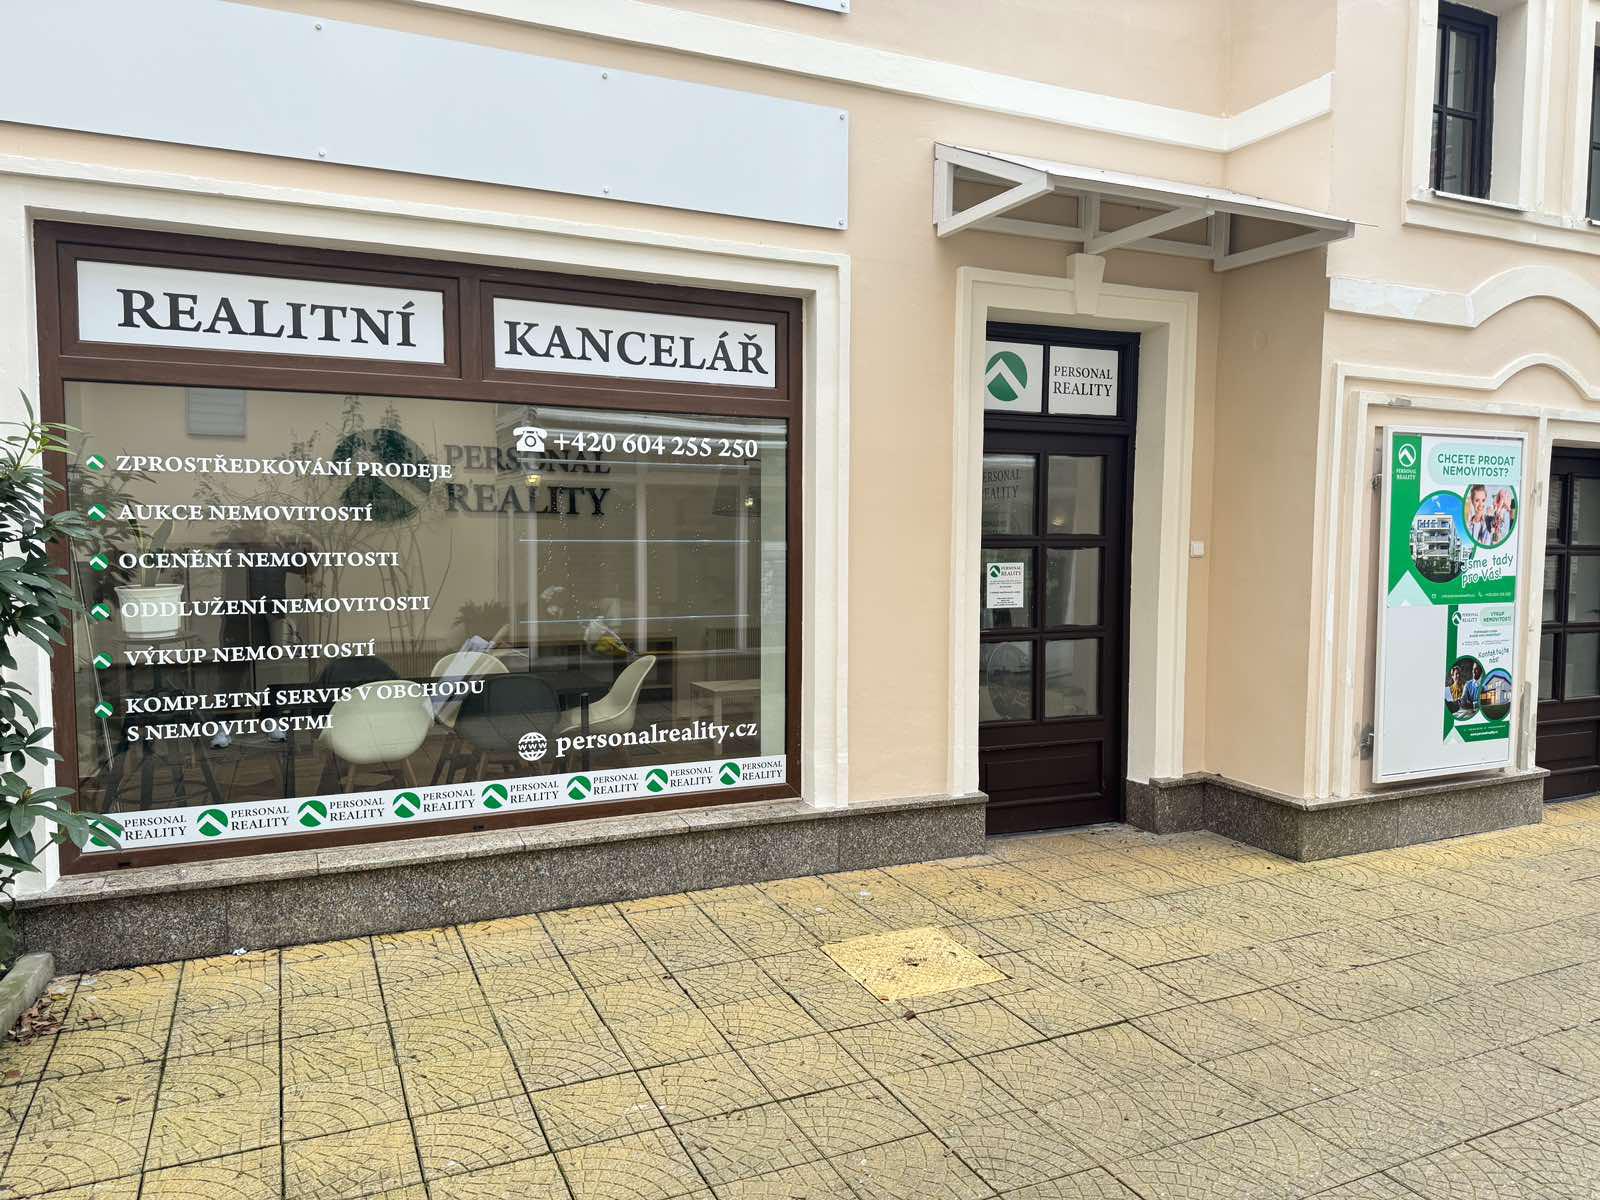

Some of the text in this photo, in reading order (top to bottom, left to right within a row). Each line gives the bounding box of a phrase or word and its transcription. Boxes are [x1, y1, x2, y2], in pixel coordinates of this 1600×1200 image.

[116, 287, 416, 347] REALITNÍ
[503, 319, 769, 374] KANCELÁŘ
[1054, 365, 1113, 380] PERSONAL
[1053, 381, 1113, 397] REALITY
[553, 431, 758, 458] +420 604 255 250
[444, 444, 611, 473] PERSONAL
[1437, 453, 1516, 466] CHCETE PRODAT
[116, 454, 452, 482] ZPROSTŘEDKOVÁNÍ PRODEJE
[983, 469, 1021, 481] ERSONAL
[1442, 465, 1509, 477] NEMOVITOST?
[444, 482, 611, 515] REALITY
[117, 503, 373, 521] AUKCE NEMOVITOSTÍ
[119, 549, 400, 569] OCENĚNÍ NEMOVITOSTI
[1461, 553, 1513, 571] Jsme tady
[1462, 573, 1479, 588] pro
[121, 595, 430, 618] ODDLUŽENÍ NEMOVITOSTI
[124, 638, 376, 666] VÝKUP NEMOVITOSTÍ
[126, 680, 485, 714] KOMPLETNÍ SERVIS V OBCHODU
[127, 714, 335, 742] S NEMOVITOSTMI
[519, 741, 547, 751] www
[555, 721, 758, 758] personalreality.cz
[670, 766, 713, 777] PERSONAL
[742, 760, 783, 770] PERSONAL
[593, 773, 639, 784] PERSONAL
[670, 775, 713, 788] REALITY
[742, 769, 783, 781] REALITY
[510, 781, 559, 792] PERSONAL
[593, 782, 639, 795] REALITY
[423, 789, 475, 800] PERSONAL
[510, 790, 559, 804] REALITY
[329, 797, 385, 809] PERSONAL
[423, 799, 475, 812] REALITY
[230, 806, 290, 818] PERSONAL
[329, 808, 385, 822] REALITY
[124, 815, 187, 828] PERSONAL
[230, 817, 290, 831] REALITY
[124, 825, 187, 841] REALITY
